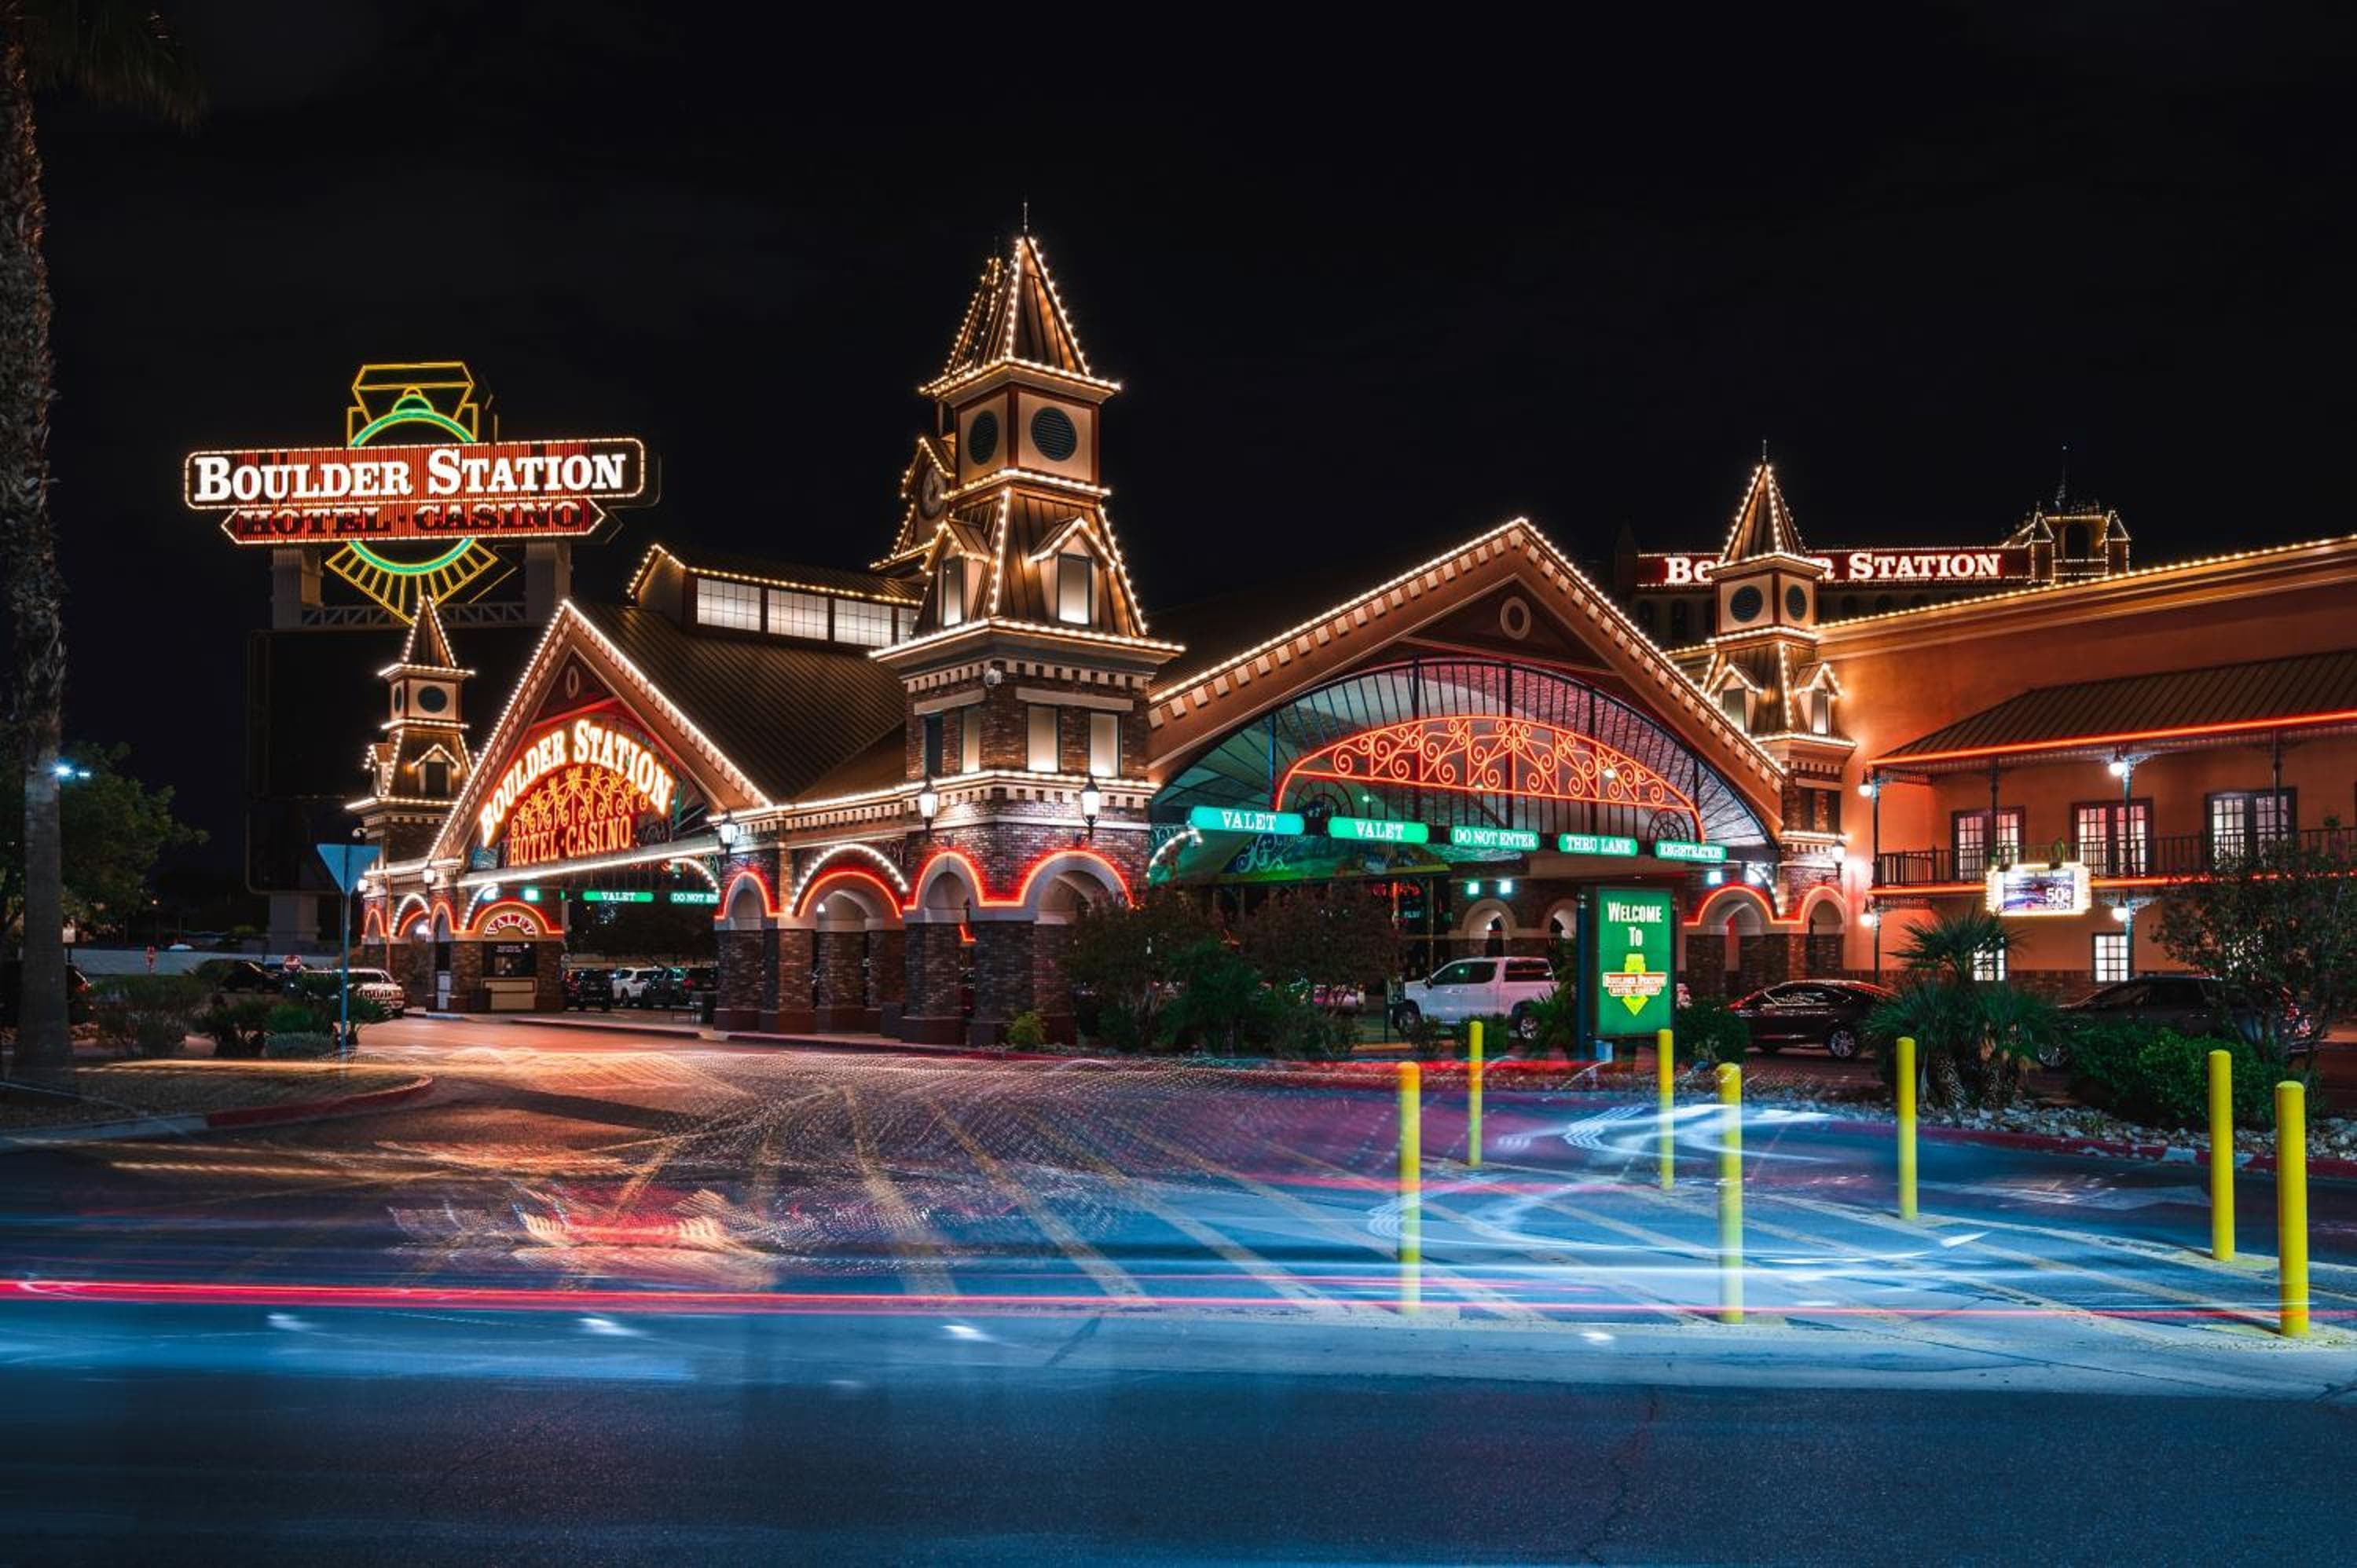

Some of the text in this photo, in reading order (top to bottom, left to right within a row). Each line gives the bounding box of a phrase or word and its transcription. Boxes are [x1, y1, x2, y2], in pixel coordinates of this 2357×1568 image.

[194, 449, 626, 501] BOULDER STATION
[238, 500, 583, 535] HOTEL CASINO
[1849, 552, 2001, 580] STATION
[479, 719, 674, 848] BOULDER STATION
[1222, 811, 1277, 831] VALET
[1354, 822, 1404, 841] VALET
[510, 815, 631, 866] HOTEL CASINO
[1454, 829, 1536, 848] DO NOT ENTER
[1566, 836, 1631, 854] THRU LANE
[601, 892, 636, 901] VALET
[673, 892, 685, 902] DO
[687, 893, 705, 903] NOT
[1607, 901, 1662, 923] WELCOME
[483, 912, 538, 936] VALET
[1627, 925, 1644, 947] TO
